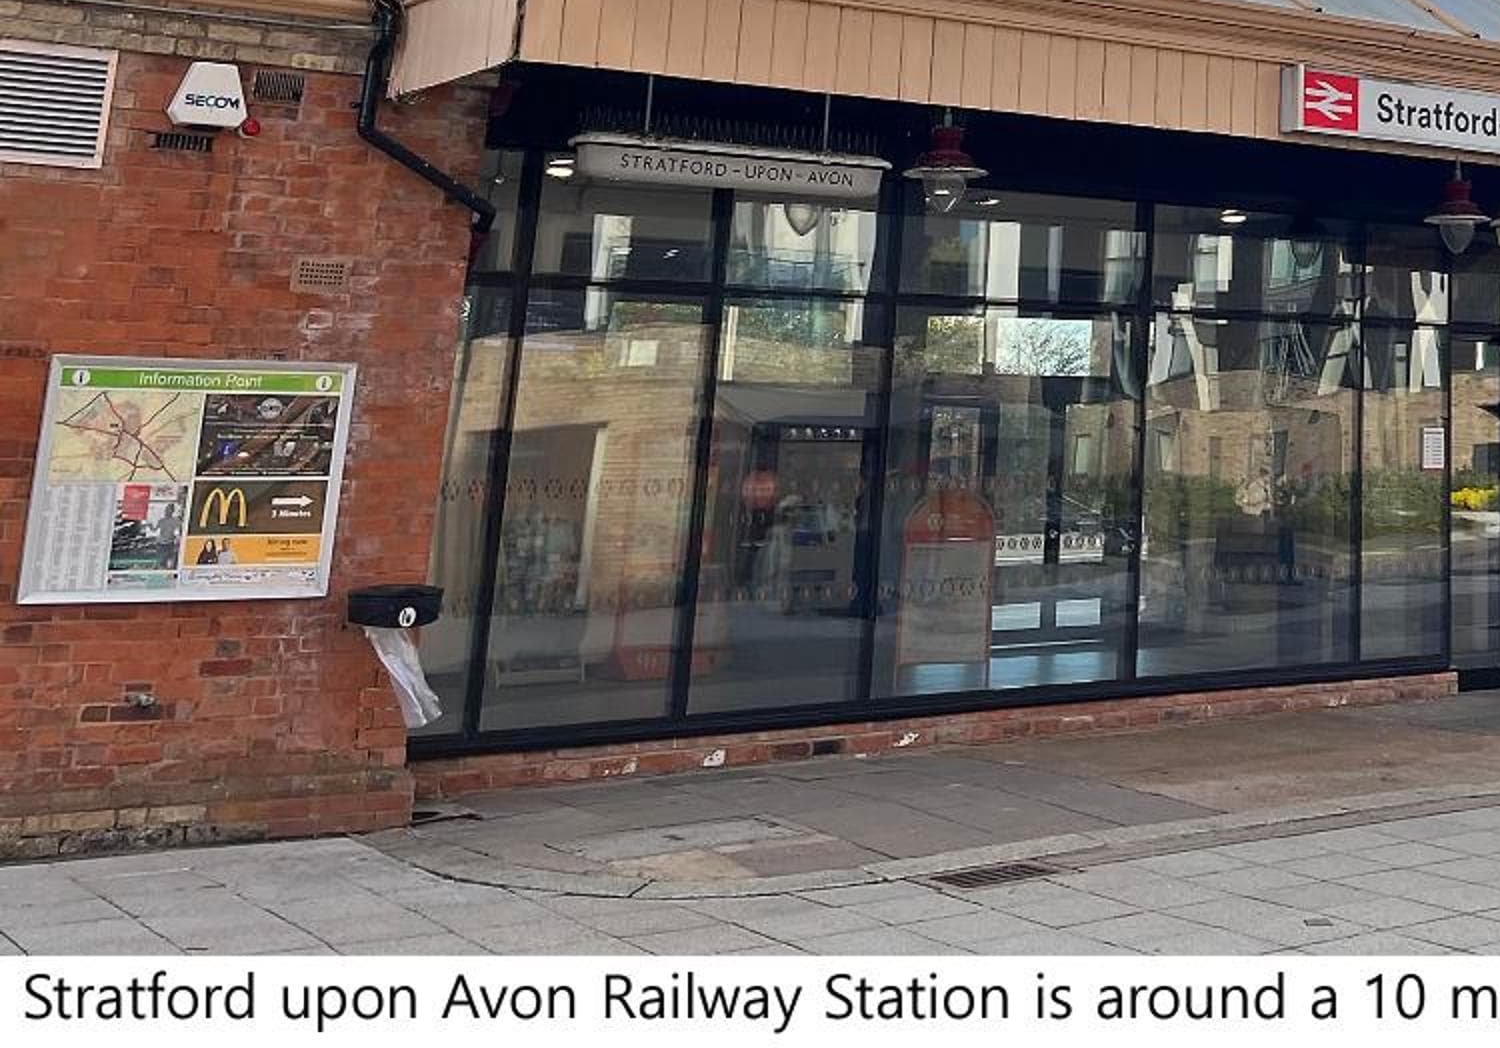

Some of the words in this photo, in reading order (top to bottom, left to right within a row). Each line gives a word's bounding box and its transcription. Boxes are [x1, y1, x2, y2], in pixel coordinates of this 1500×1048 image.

[185, 94, 240, 109] SECOM
[139, 372, 220, 387] Information
[225, 374, 263, 388] Point
